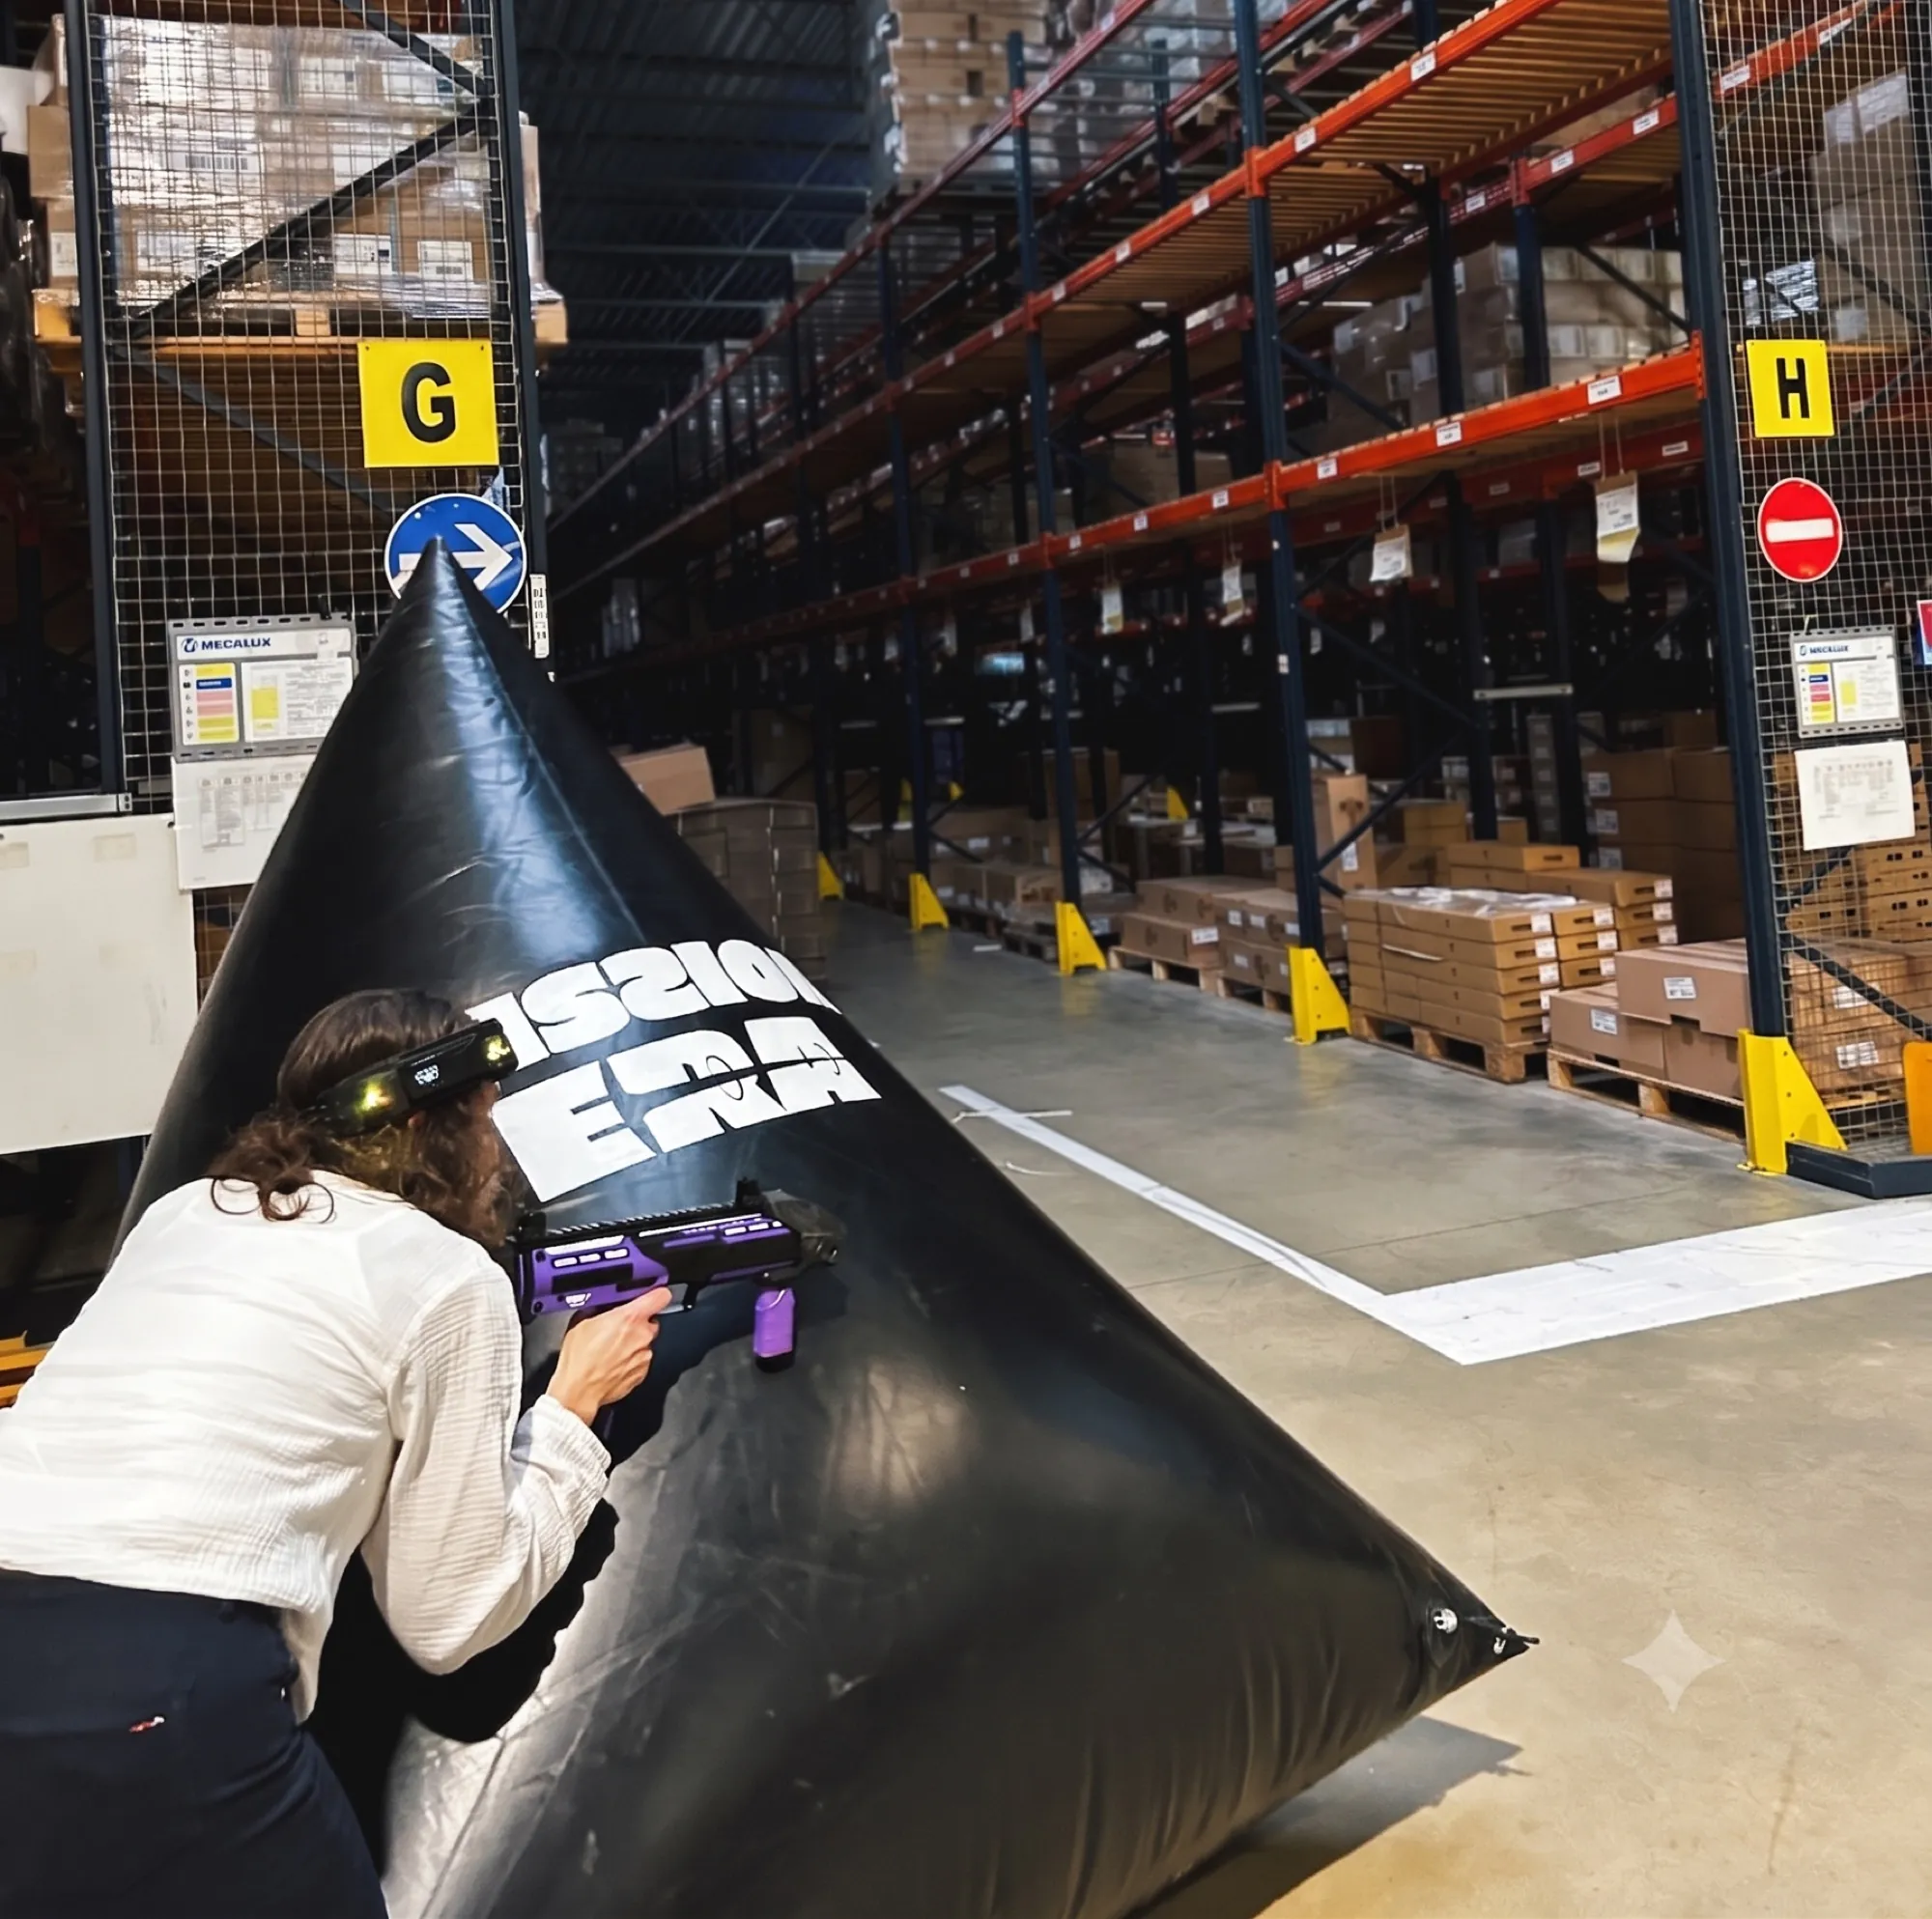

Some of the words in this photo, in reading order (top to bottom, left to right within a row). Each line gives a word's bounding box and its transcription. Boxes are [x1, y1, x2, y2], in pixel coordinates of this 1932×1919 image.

[401, 362, 457, 443] G
[1776, 357, 1810, 419] H
[201, 637, 271, 651] MECALUX
[491, 1016, 883, 1202] ERA
